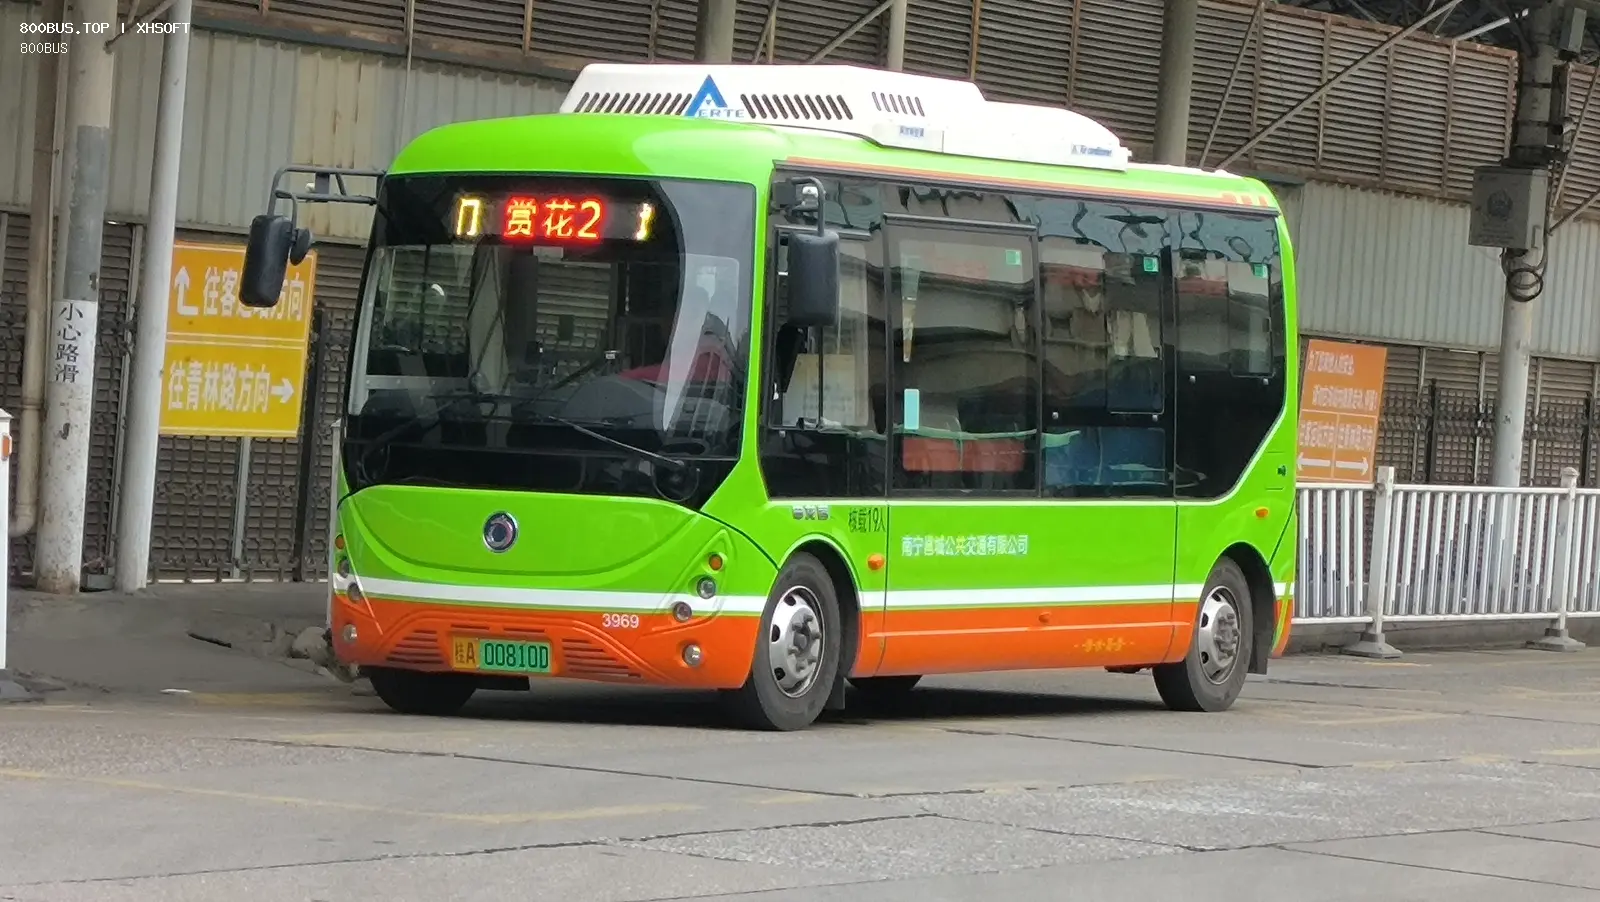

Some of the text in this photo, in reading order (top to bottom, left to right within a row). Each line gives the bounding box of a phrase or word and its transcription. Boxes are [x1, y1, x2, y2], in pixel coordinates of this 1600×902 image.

[506, 199, 601, 238] 赏花2
[55, 302, 84, 383] 小心路滑
[167, 360, 271, 414] 往青林路方向
[901, 534, 1029, 557] 南宁邕城公共交通有限公司
[602, 612, 640, 629] 3969
